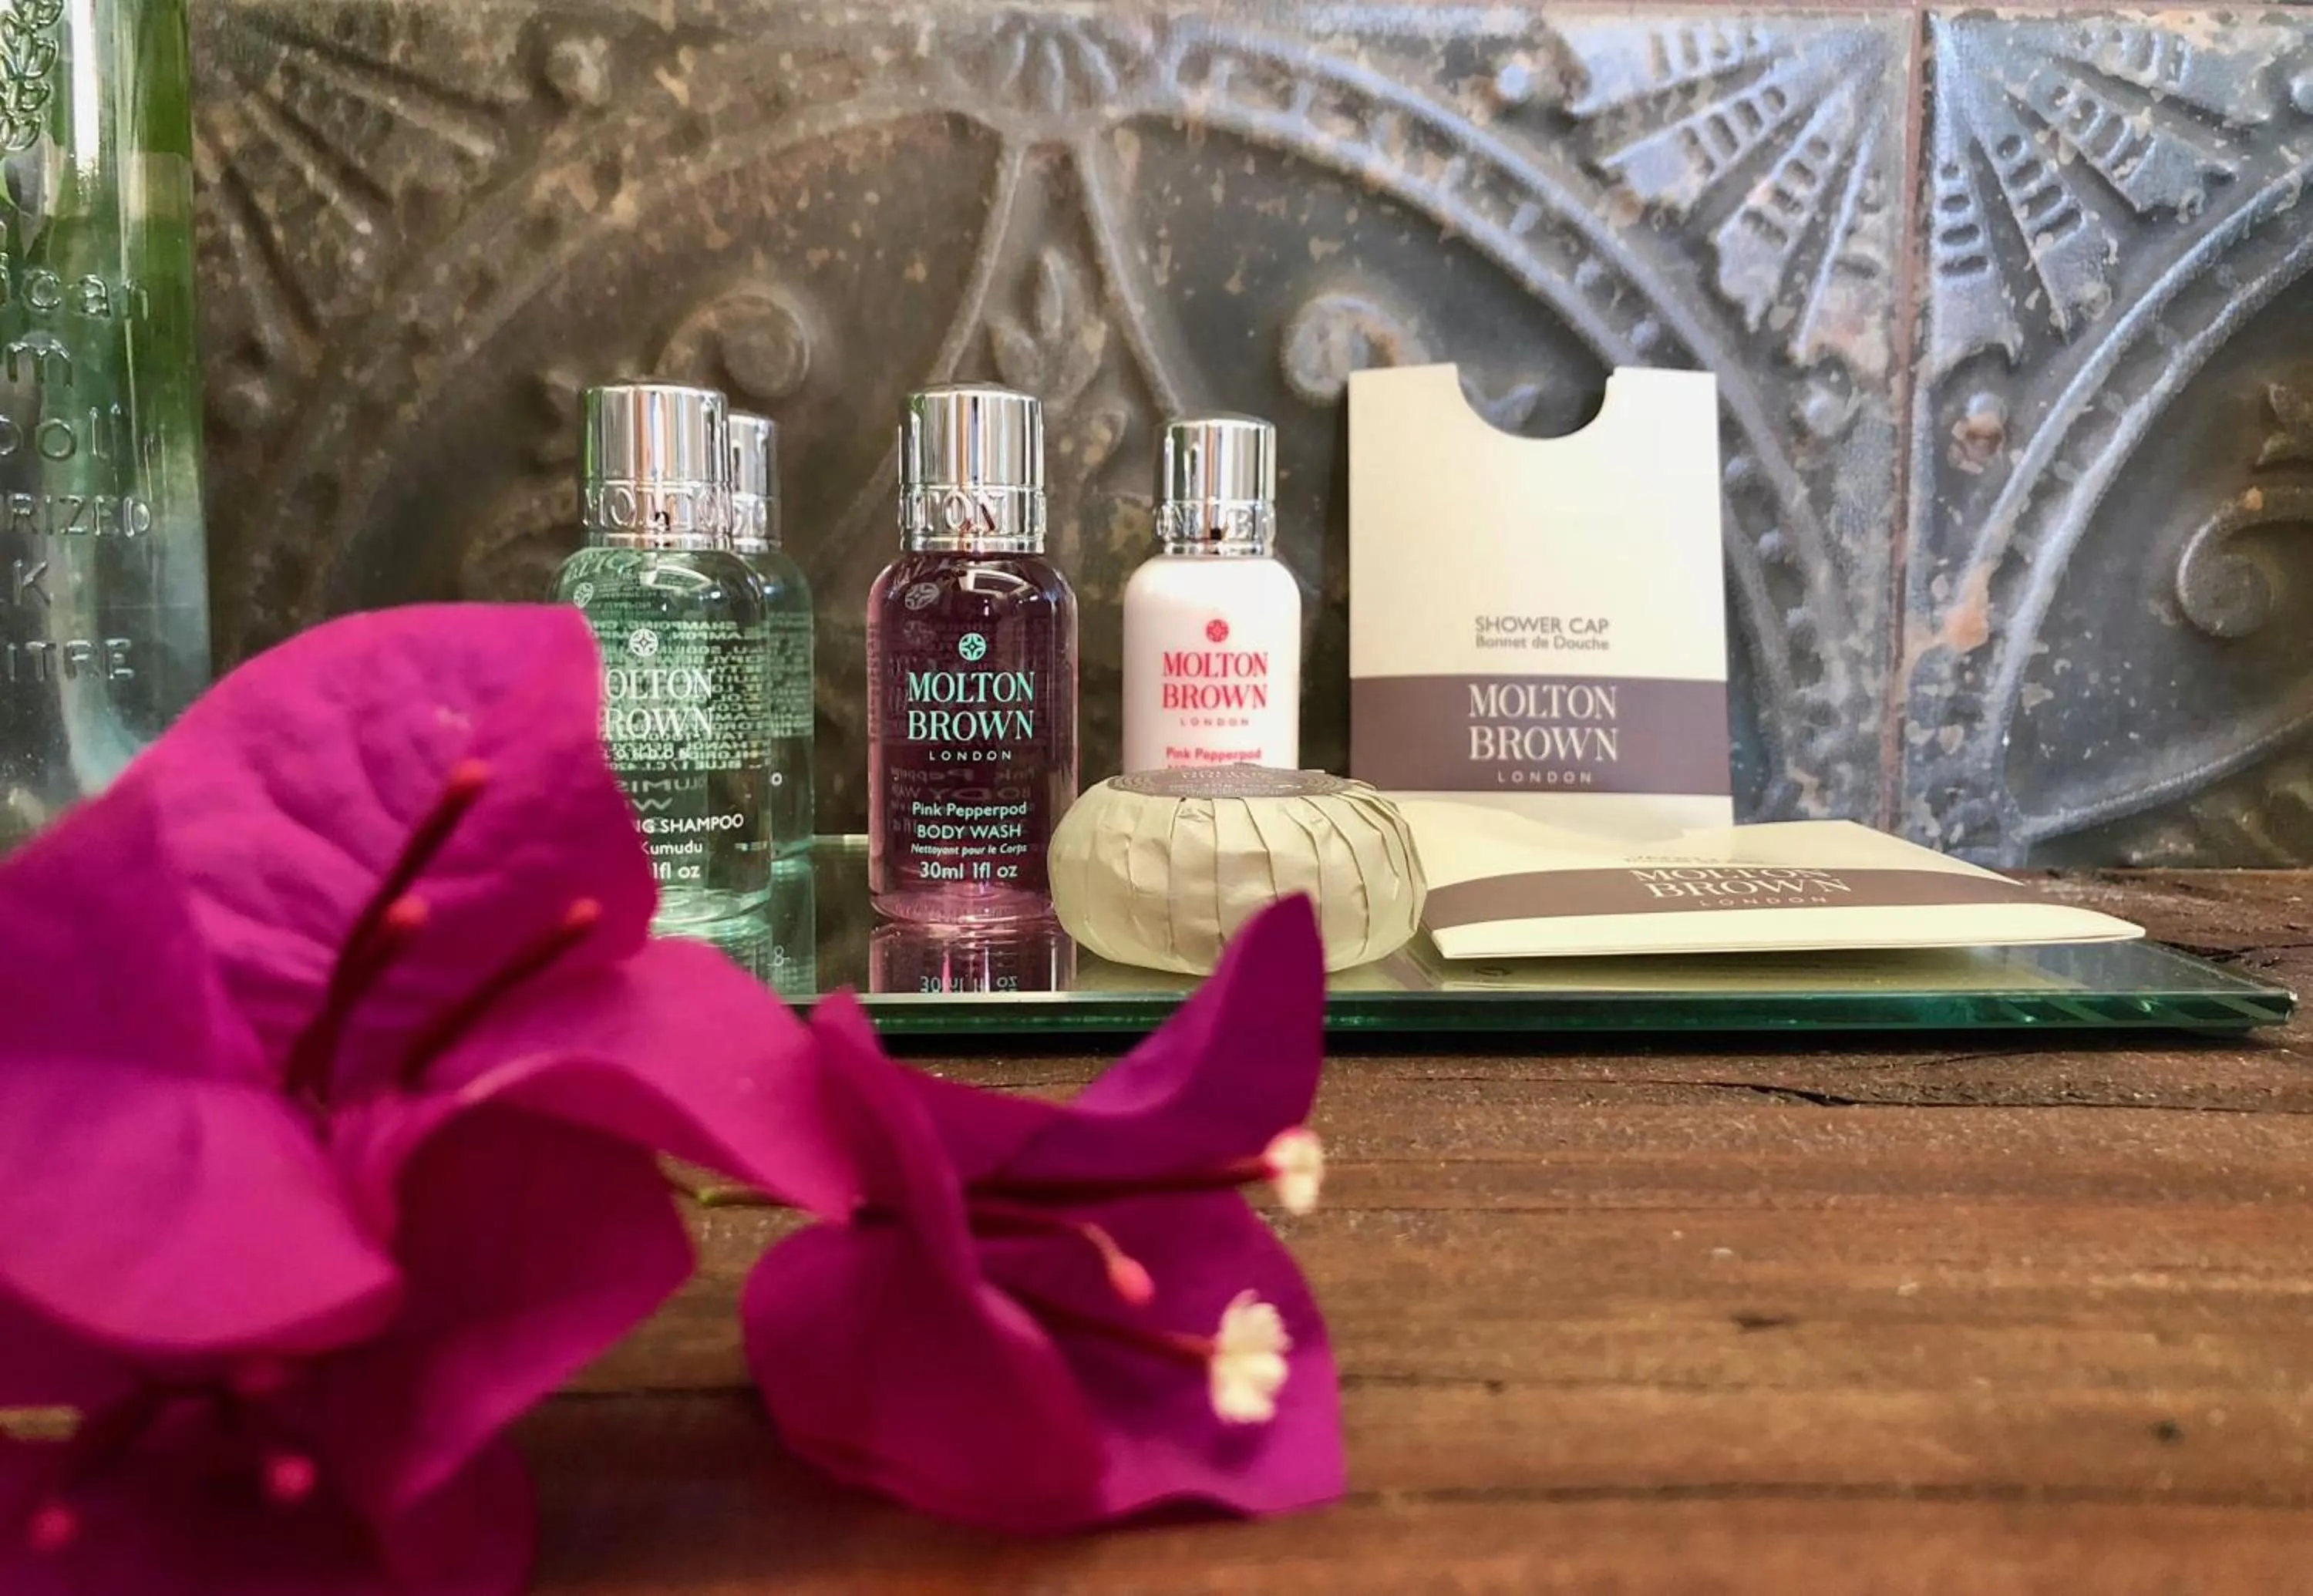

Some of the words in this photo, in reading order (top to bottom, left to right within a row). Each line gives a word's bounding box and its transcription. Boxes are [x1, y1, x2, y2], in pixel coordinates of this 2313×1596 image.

[8, 493, 151, 538] RIZED
[1475, 616, 1562, 634] SHOWER
[1569, 618, 1610, 635] CAP
[1476, 635, 1527, 649] Bonnet
[1532, 636, 1549, 650] de
[1554, 635, 1610, 651] Douche
[6, 637, 136, 683] ITRE
[1163, 652, 1268, 678] MOLTON
[604, 668, 714, 699] OLTON
[907, 671, 1035, 704] MOLTON
[1162, 683, 1268, 710] BROWN
[1468, 683, 1618, 720] MOLTON
[604, 707, 714, 741] ROWN
[907, 709, 1035, 742] BROWN
[1180, 717, 1250, 727] LONDON
[1166, 746, 1190, 760] Pink
[1468, 726, 1619, 763] BROWN
[929, 749, 1012, 761] LONDON
[1497, 770, 1592, 785] LONDON
[912, 801, 942, 817] Pink
[947, 801, 1027, 821] Pepperpod
[660, 813, 745, 833] SHAMPOO
[917, 824, 965, 840] BODY
[970, 823, 1022, 840] WASH
[911, 843, 959, 857] Nettoyant
[961, 846, 985, 857] pour
[988, 844, 996, 854] le
[999, 843, 1028, 856] Corps
[678, 865, 702, 879] oz
[920, 861, 964, 880] 30ml
[973, 861, 991, 880] 1fl
[997, 865, 1018, 878] oz
[1643, 877, 1851, 898] BROWN
